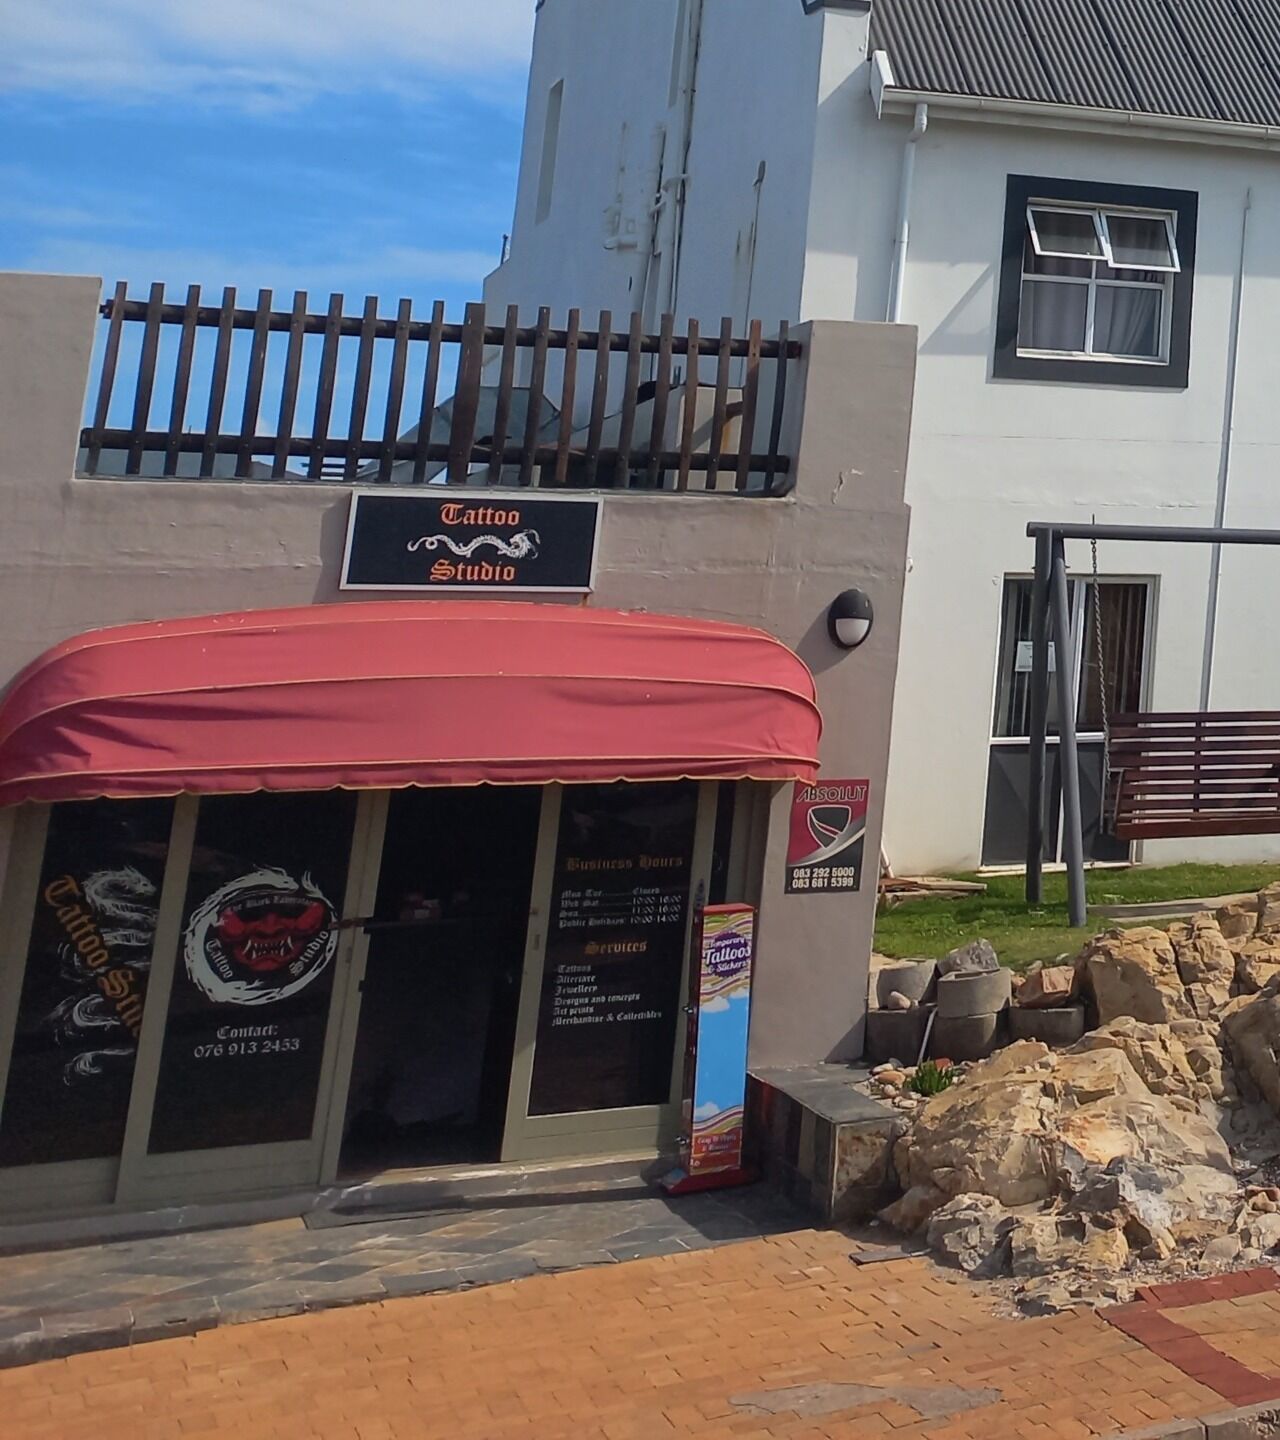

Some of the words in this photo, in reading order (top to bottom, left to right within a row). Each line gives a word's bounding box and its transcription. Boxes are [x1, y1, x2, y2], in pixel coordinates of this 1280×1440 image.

[440, 502, 520, 526] Tattoo
[429, 558, 516, 582] Studio
[796, 785, 868, 803] ABSOLUT
[792, 878, 809, 888] 083
[831, 877, 854, 887] 5399
[793, 868, 811, 878] 083
[812, 867, 830, 878] 292
[45, 874, 109, 968] Tattoo
[289, 929, 329, 977] Studio
[584, 940, 648, 956] Services
[704, 945, 752, 965] Tattoos
[205, 938, 235, 979] Tattoo
[194, 1042, 223, 1058] 076
[228, 1040, 257, 1057] 913
[261, 1038, 300, 1053] 2453
